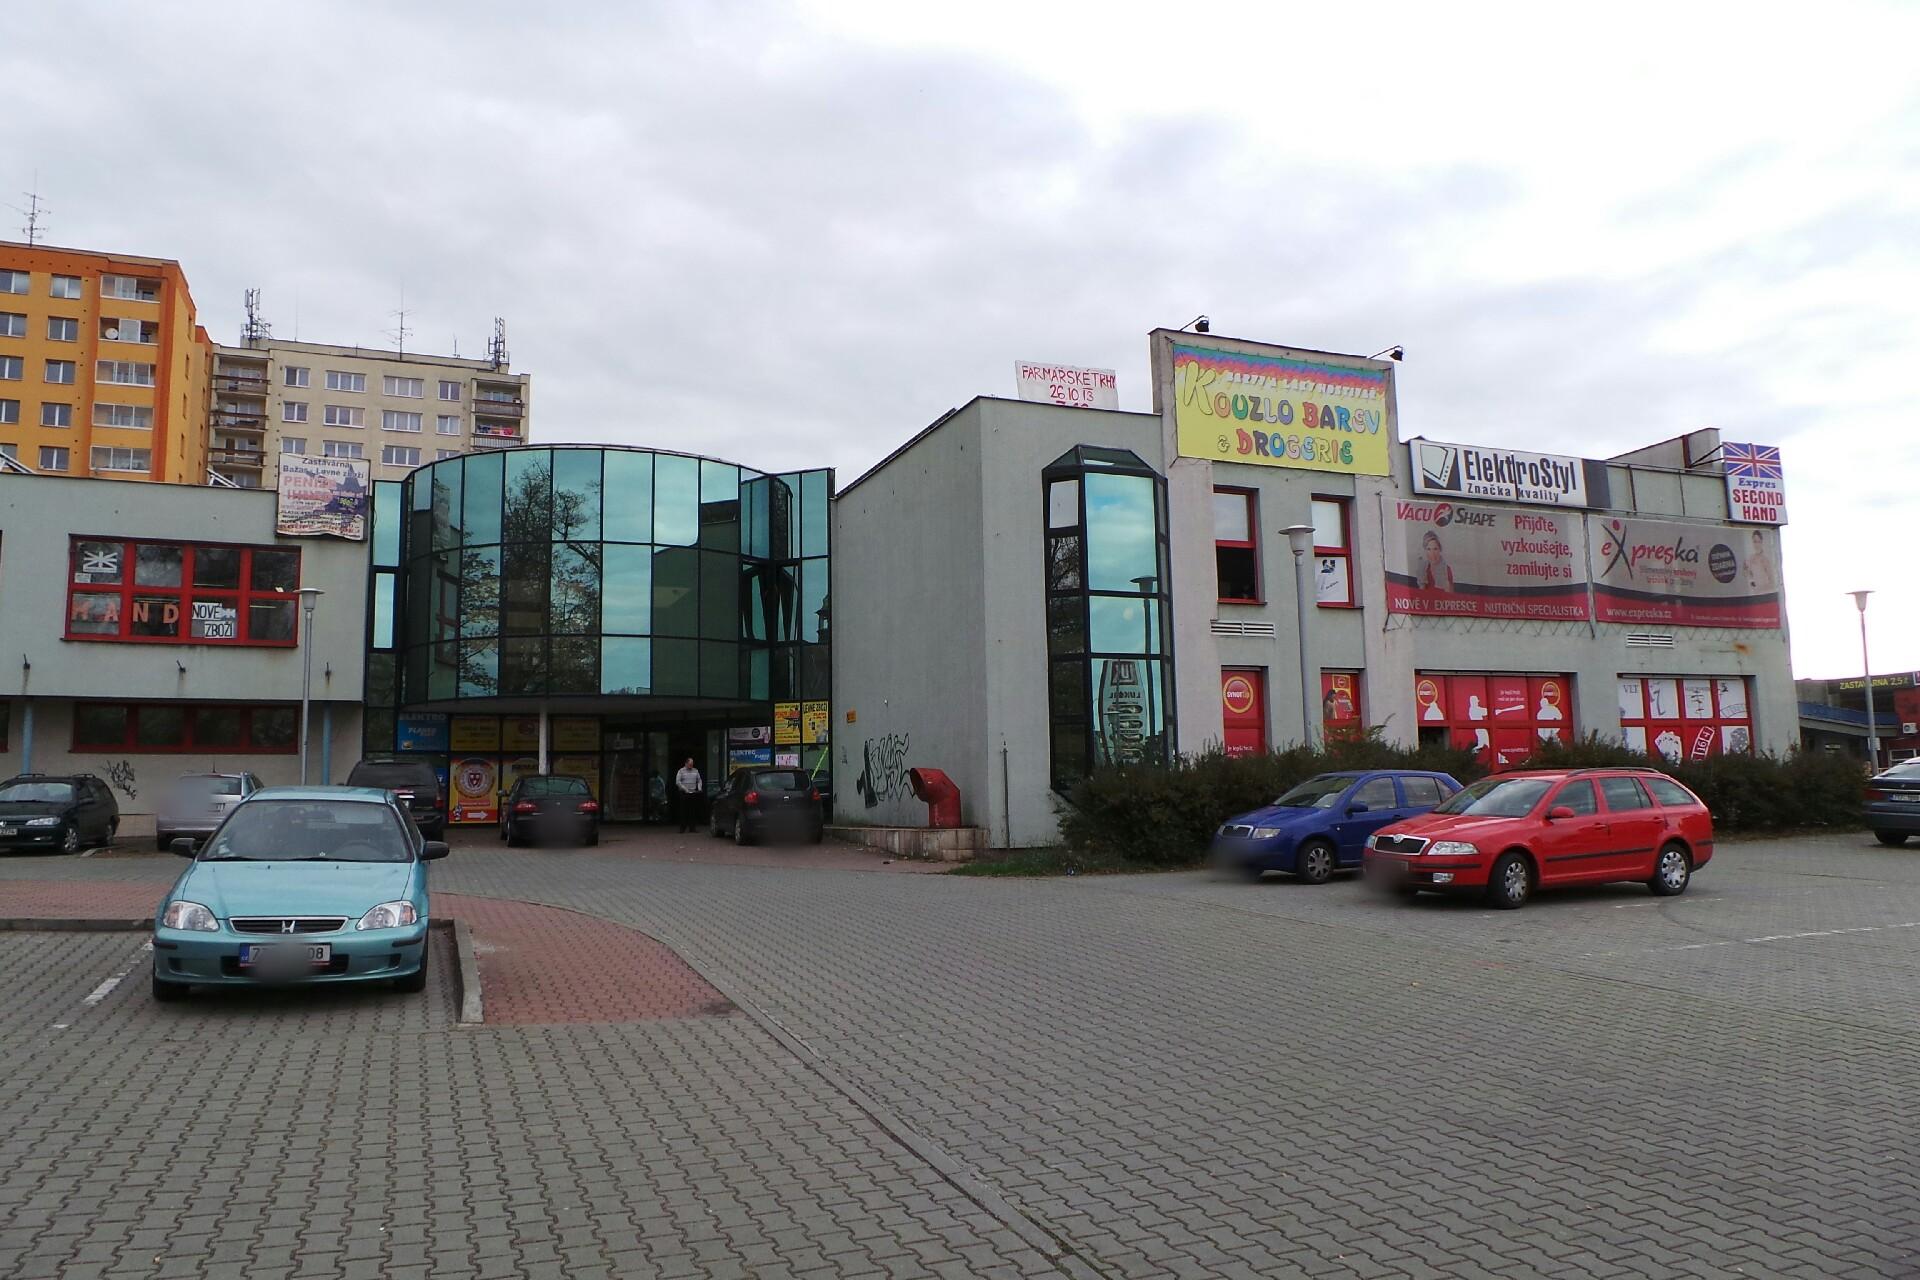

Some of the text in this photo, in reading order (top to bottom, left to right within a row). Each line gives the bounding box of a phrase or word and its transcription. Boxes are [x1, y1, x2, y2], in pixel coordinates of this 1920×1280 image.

[1049, 384, 1066, 400] 26
[1068, 387, 1080, 401] 10
[1184, 360, 1294, 425] KOUZLO
[1235, 427, 1354, 465] DROGERIE
[1463, 449, 1577, 495] ElektroStyl
[1467, 482, 1559, 502] Značka kvality
[1738, 477, 1776, 489] Expres
[1732, 488, 1784, 506] SECOND
[1743, 505, 1777, 522] HAND
[1514, 513, 1558, 535] Přijďte,
[1501, 539, 1573, 558] vyzkoušejte,
[1562, 565, 1572, 578] si
[192, 603, 222, 620] NOVÉ
[1422, 599, 1429, 610] V
[1527, 603, 1584, 616] SPECIALISTKA
